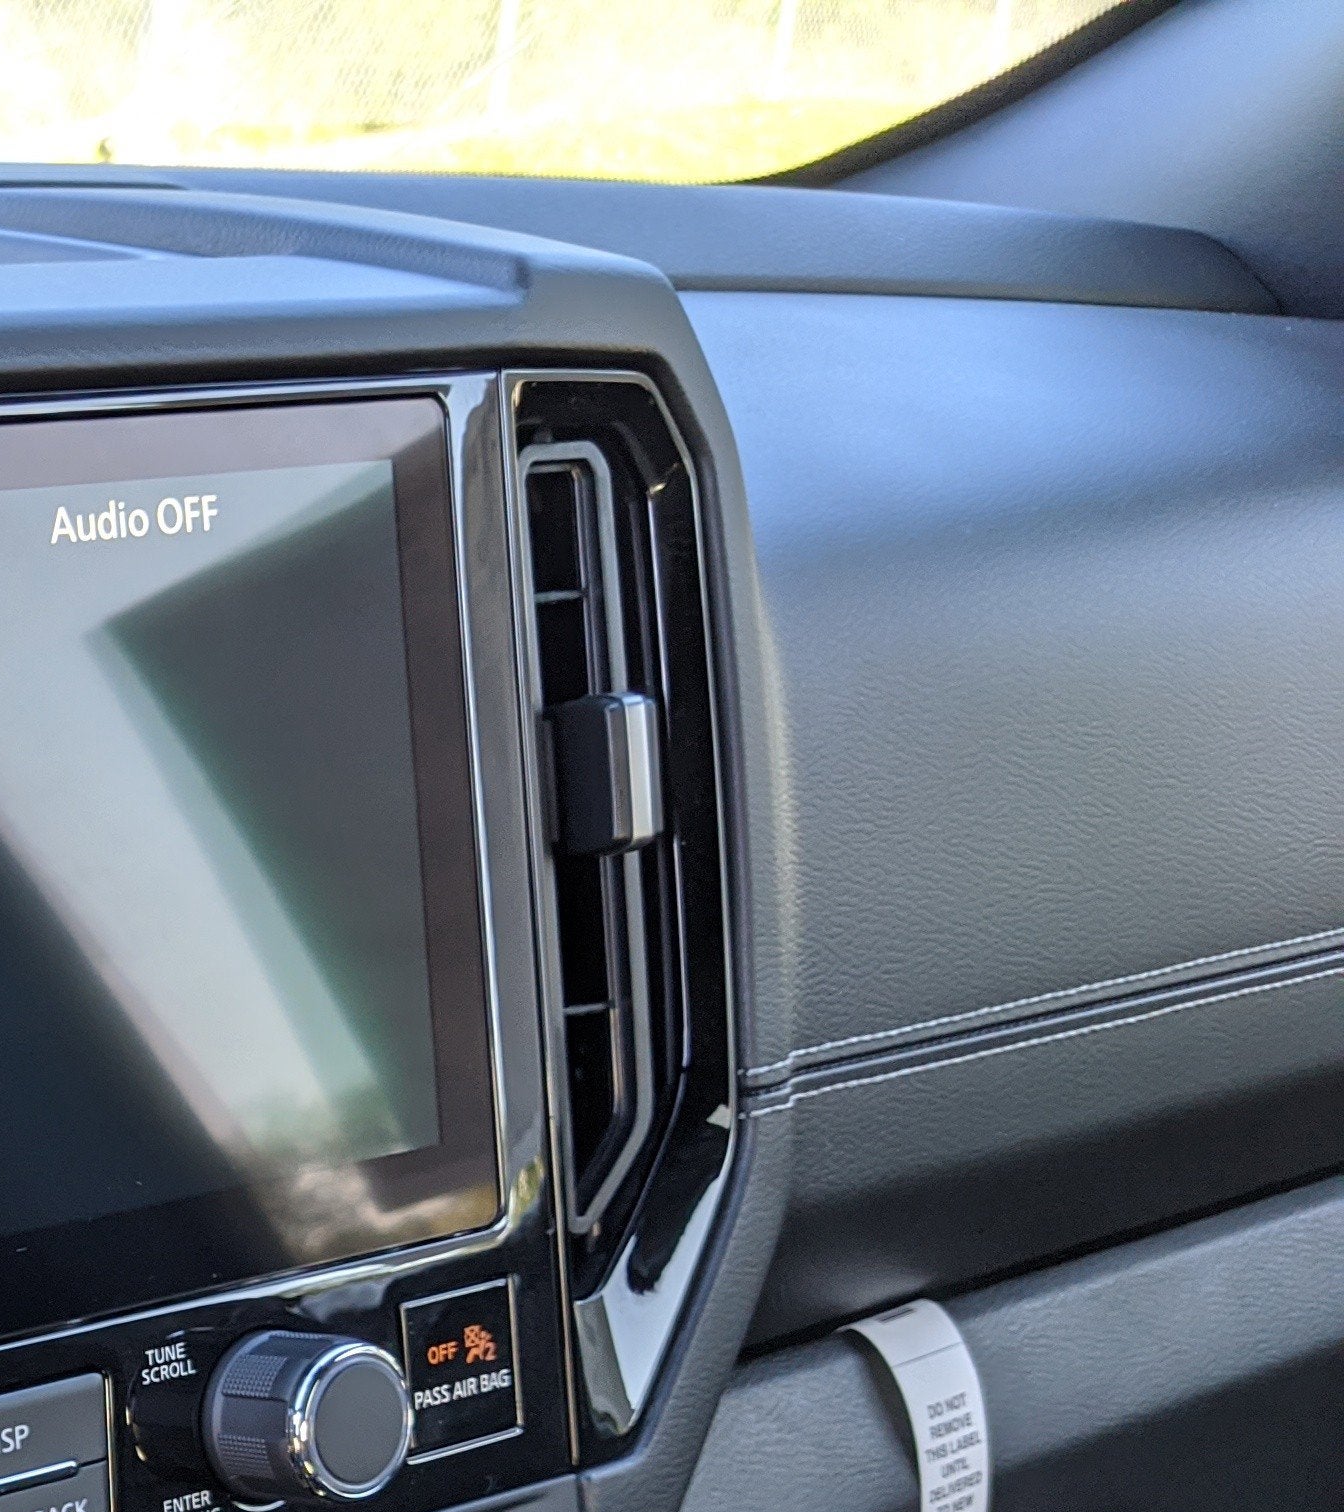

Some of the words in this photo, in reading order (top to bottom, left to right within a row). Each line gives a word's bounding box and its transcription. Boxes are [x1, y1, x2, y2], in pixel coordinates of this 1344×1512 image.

[50, 499, 150, 545] Audio
[156, 494, 219, 534] OFF
[144, 1341, 187, 1366] TUNE
[427, 1340, 460, 1365] OFF
[140, 1357, 197, 1386] SCROLL
[414, 1382, 450, 1411] PASS
[452, 1375, 479, 1401] AIR
[480, 1367, 512, 1393] BAG
